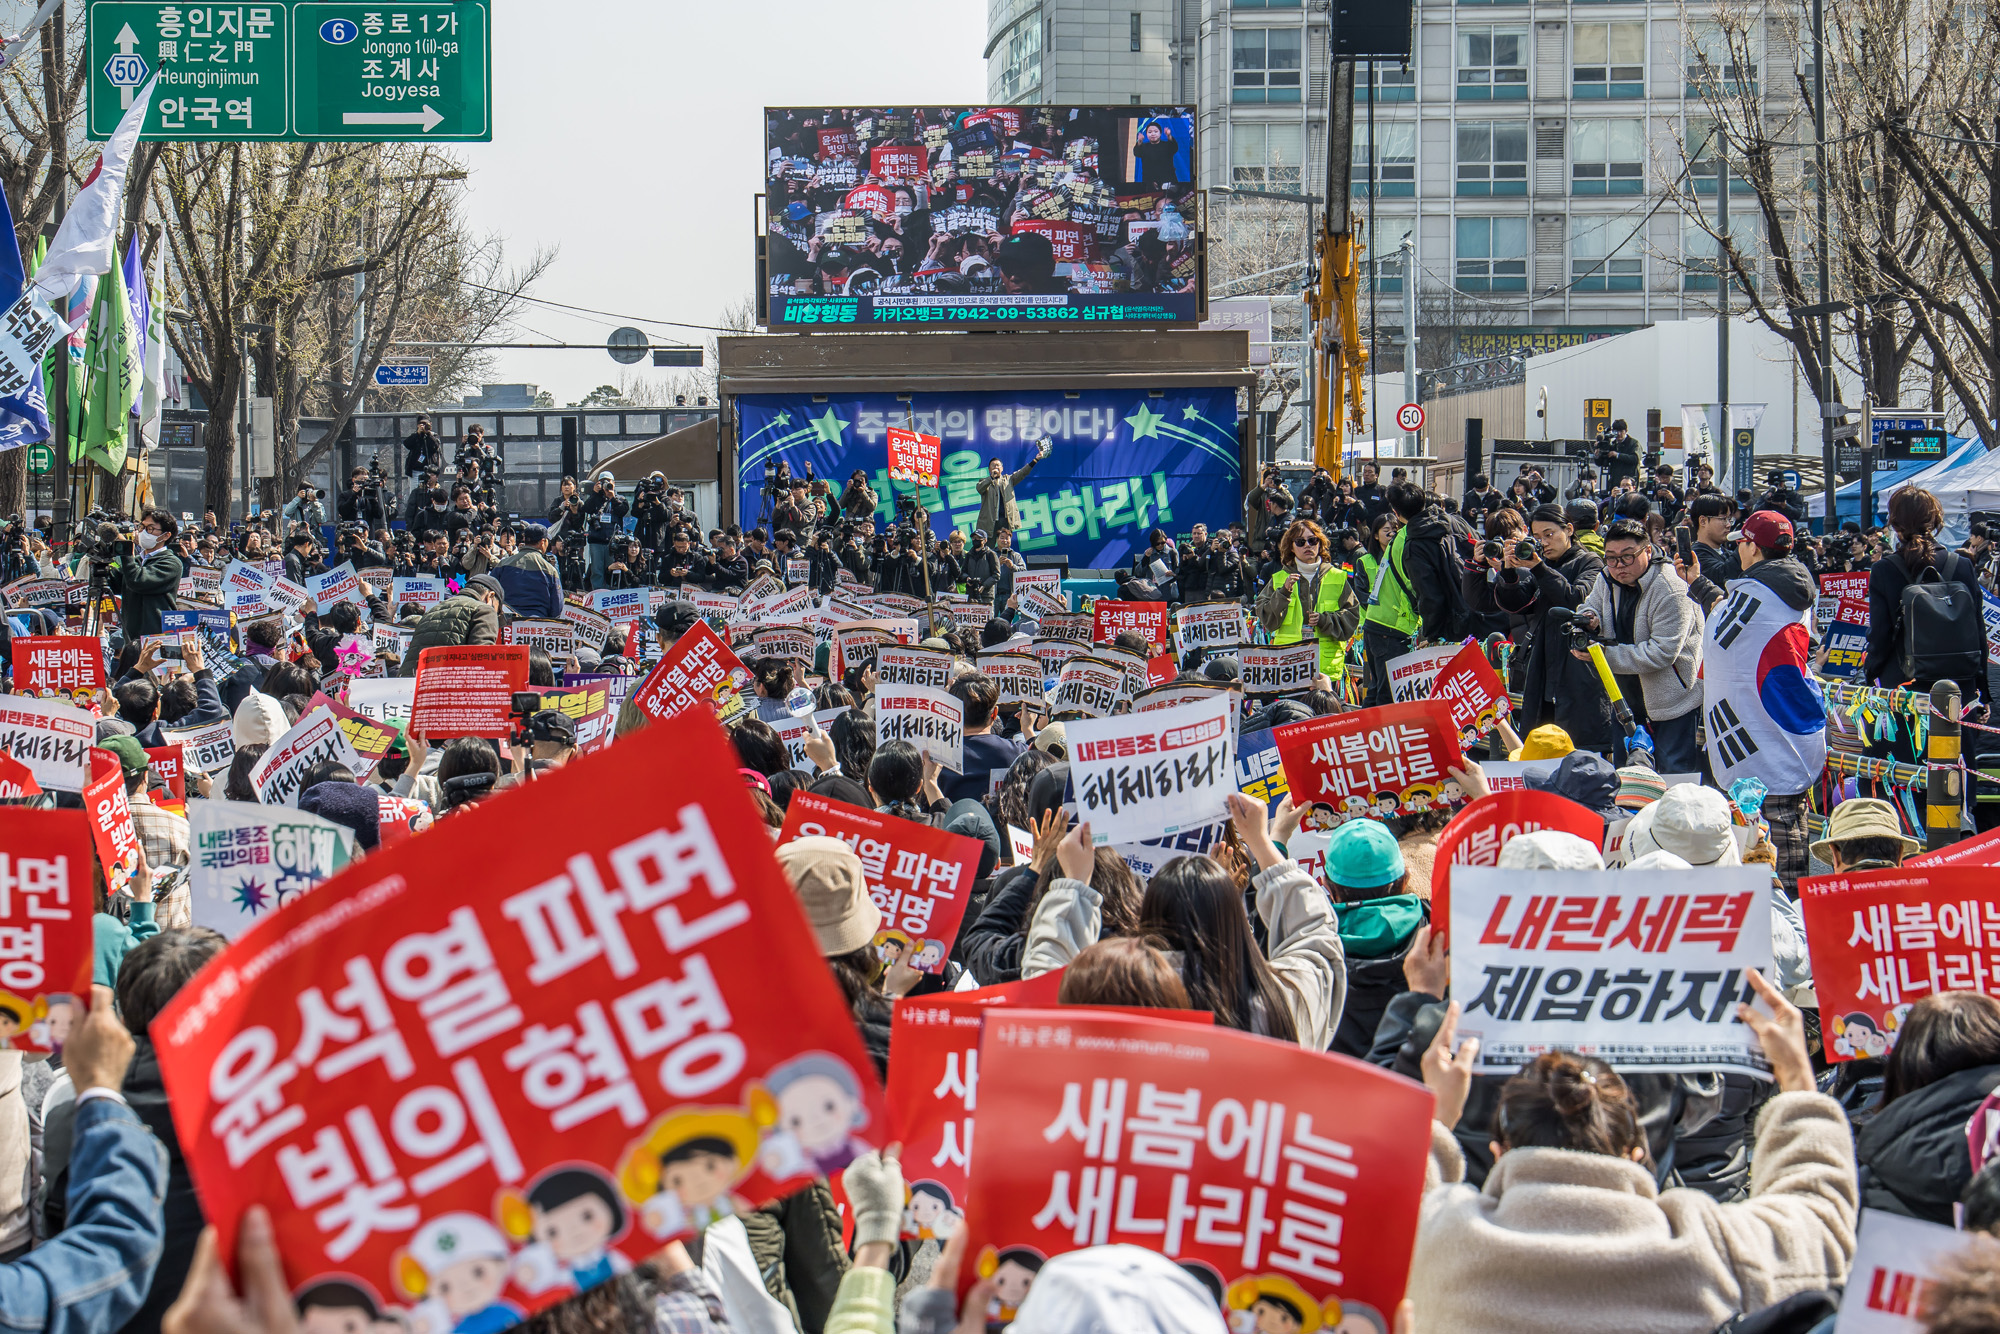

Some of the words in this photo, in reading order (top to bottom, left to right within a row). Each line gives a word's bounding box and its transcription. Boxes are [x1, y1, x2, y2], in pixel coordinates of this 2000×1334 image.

[157, 7, 275, 40] 흥인지문
[332, 23, 346, 41] 6
[158, 41, 254, 64] 興仁之門
[362, 38, 412, 58] Jongno
[414, 38, 459, 57] 1(il)-ga
[115, 60, 139, 81] 50
[157, 67, 259, 89] Heunginjimun
[361, 57, 440, 82] 조계사
[361, 82, 441, 101] Jogyesa
[159, 97, 253, 129] 안국역
[878, 153, 919, 165] 새봄에는
[879, 165, 920, 177] 새나라로
[784, 304, 858, 323] 비상행동
[873, 307, 945, 322] 카카오뱅크
[948, 306, 1079, 321] 7942-09-53862
[1082, 305, 1124, 320] 심규협
[1207, 312, 1265, 325] 종로경찰서
[386, 376, 427, 385] Yunposun-gil
[985, 408, 1116, 441] 명령이다!
[1402, 410, 1420, 425] 50
[891, 437, 919, 456] 윤석열
[919, 443, 938, 460] 파면
[897, 453, 916, 470] 빛의
[916, 457, 934, 473] 혁명
[317, 574, 359, 603] 파면선고!
[320, 568, 348, 589] 헌재는
[405, 580, 433, 592] 헌재는
[1823, 579, 1848, 592] 윤석열
[1849, 577, 1867, 589] 파면
[237, 593, 262, 605] 헌재는
[399, 590, 440, 602] 파면선고!
[601, 592, 639, 608] 윤석열은
[1846, 588, 1863, 600] 혁명
[953, 613, 991, 624] 해체하라
[1099, 610, 1136, 626] 윤석열
[1137, 611, 1162, 627] 파면
[1180, 613, 1204, 625] 내란동조
[516, 627, 544, 635] 내란동조
[758, 634, 786, 643] 내란동조
[844, 635, 874, 646] 내란동조
[1181, 620, 1243, 645] 해체하라
[28, 649, 94, 668] 새봄에는
[759, 641, 814, 661] 해체하라
[883, 655, 914, 665] 내란동조
[1035, 649, 1066, 657] 내란동조
[1243, 655, 1279, 666] 내란동조
[29, 667, 96, 688] 새나라로
[646, 663, 690, 718] 윤석열
[680, 635, 719, 672] 파면
[688, 658, 727, 694] 혁명
[880, 664, 949, 689] 해체하라
[982, 664, 1016, 675] 내란동조
[1242, 663, 1317, 687] 해체하라
[1392, 660, 1435, 680] 내란동조
[880, 697, 930, 711] 내란동조
[1055, 682, 1115, 714] 해체하라
[880, 712, 961, 750] 해체하라!
[1280, 726, 1308, 737] 나눔문화
[1308, 716, 1360, 733] www.nanum.com
[1077, 734, 1157, 763] 내란동조
[1164, 718, 1223, 748] 국민의힘
[1310, 723, 1430, 766] 새봄에는
[256, 747, 293, 788] 내란동조
[294, 718, 333, 748] 국민의힘
[1081, 740, 1228, 815] 해체하라!
[1319, 751, 1440, 798] 새나라로
[796, 795, 829, 813] 나눔문화
[829, 806, 883, 828] www.nanum.com
[199, 825, 270, 848] 내란동조
[199, 844, 271, 869] 국민의힘
[891, 849, 962, 900] 파면
[1806, 879, 1850, 896] 나눔문화
[1852, 876, 1929, 891] www.nanum.com
[868, 883, 935, 935] 혁명
[1479, 889, 1754, 953] 내란세력
[208, 903, 523, 1171] 윤석열
[503, 800, 752, 982] 파면
[1855, 951, 2000, 1005] 새나라
[1074, 1034, 1210, 1062] www.nanum.com
[275, 1056, 526, 1262] 빛의
[503, 951, 748, 1133] 혁명
[1042, 1076, 1359, 1206] 새봄에는
[1031, 1165, 1345, 1287] 새나라로
